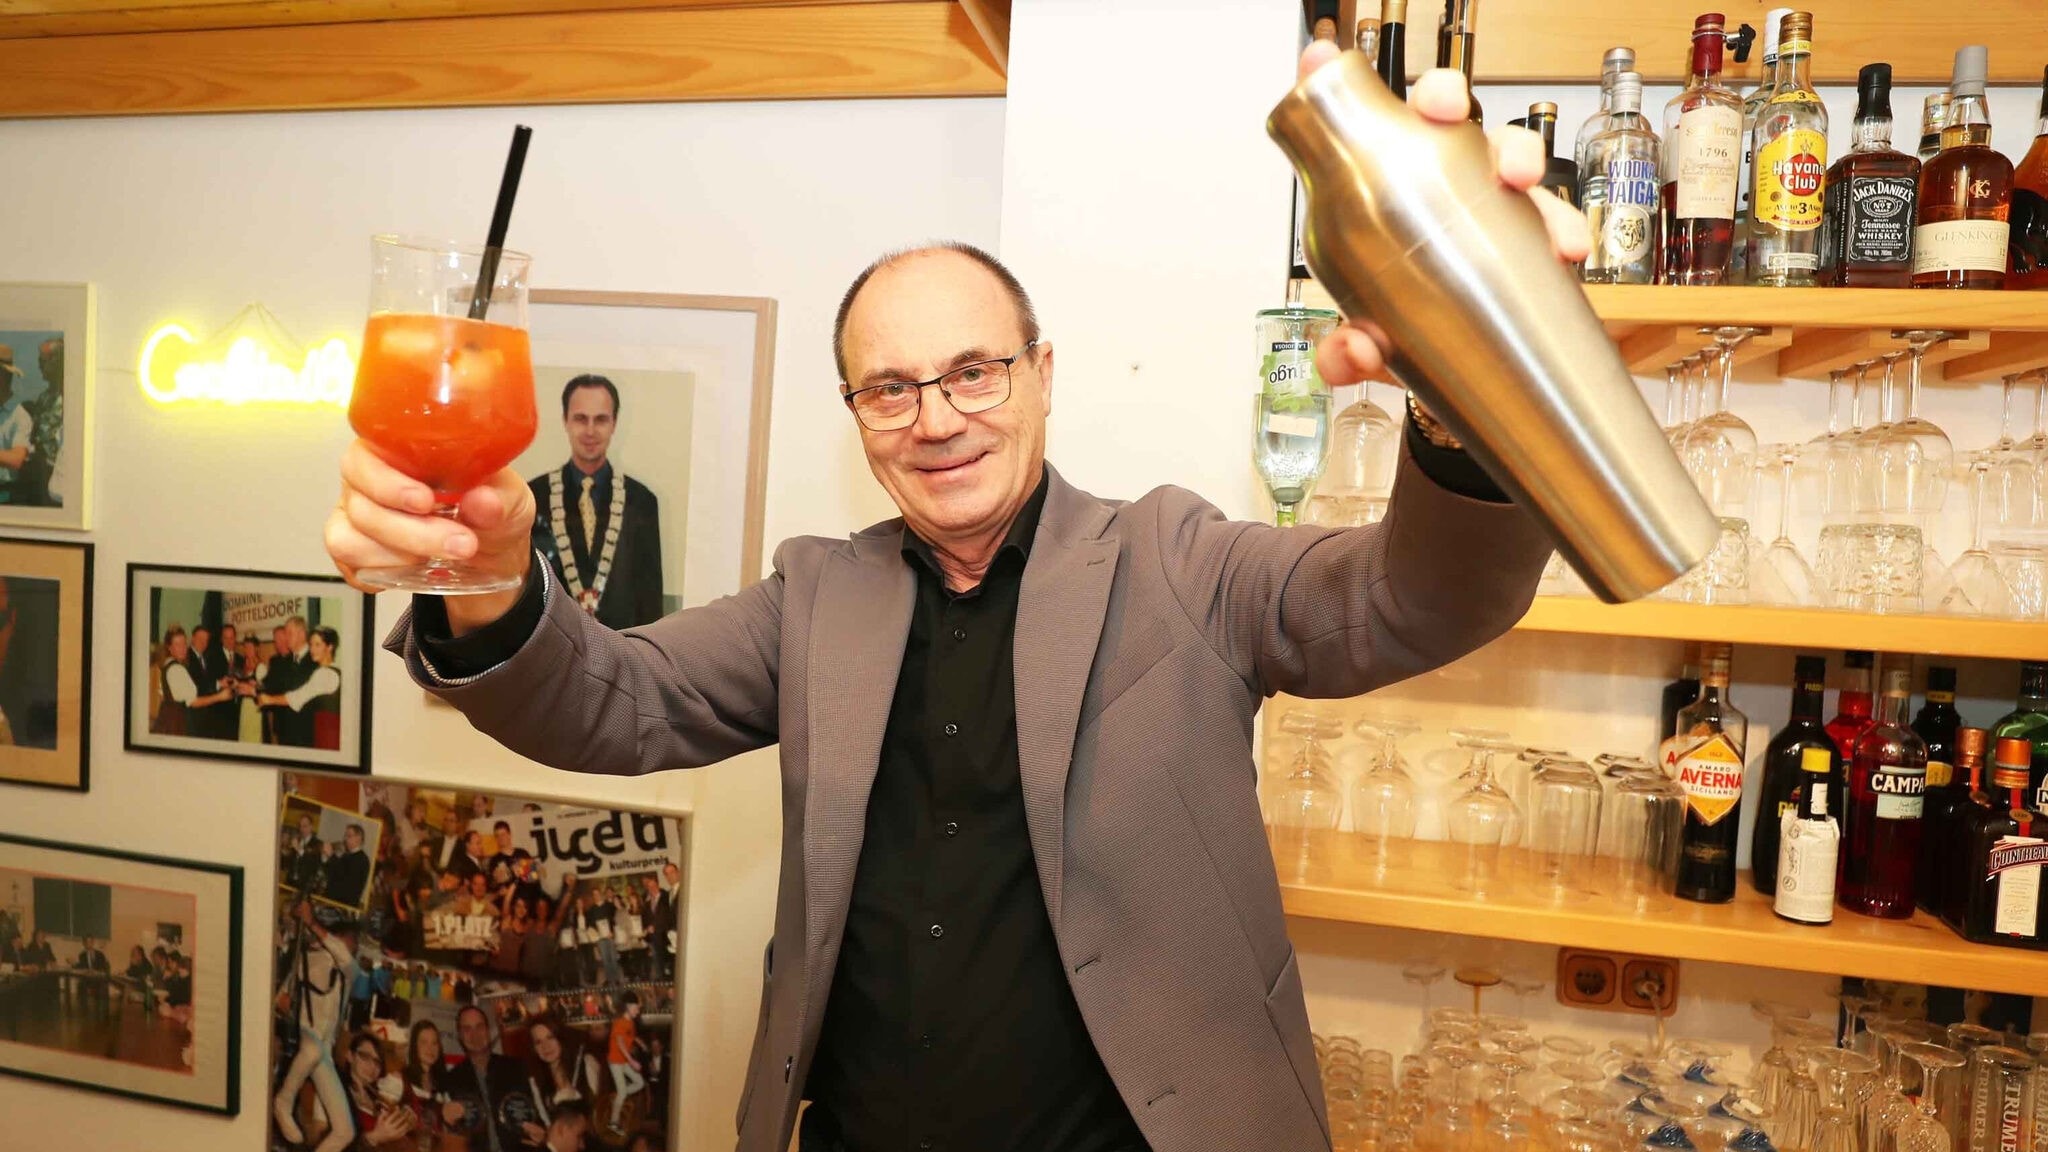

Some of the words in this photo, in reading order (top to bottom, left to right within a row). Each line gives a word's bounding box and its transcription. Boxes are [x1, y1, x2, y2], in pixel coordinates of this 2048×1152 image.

[1700, 147, 1728, 158] 1796
[1607, 160, 1656, 179] WODKA
[1773, 160, 1824, 176] Havana
[1783, 175, 1817, 190] Club
[1607, 180, 1655, 206] TAIGA
[1853, 184, 1877, 202] JACK
[1877, 181, 1914, 203] DANIEL'S
[1798, 202, 1807, 214] 3
[1861, 219, 1900, 229] Tennessee
[1858, 232, 1903, 240] WHISKEY
[1699, 764, 1732, 773] AMARO
[1680, 767, 1742, 789] AVERNA
[1690, 786, 1734, 796] SICILIANO
[609, 855, 669, 871] kulturpreis
